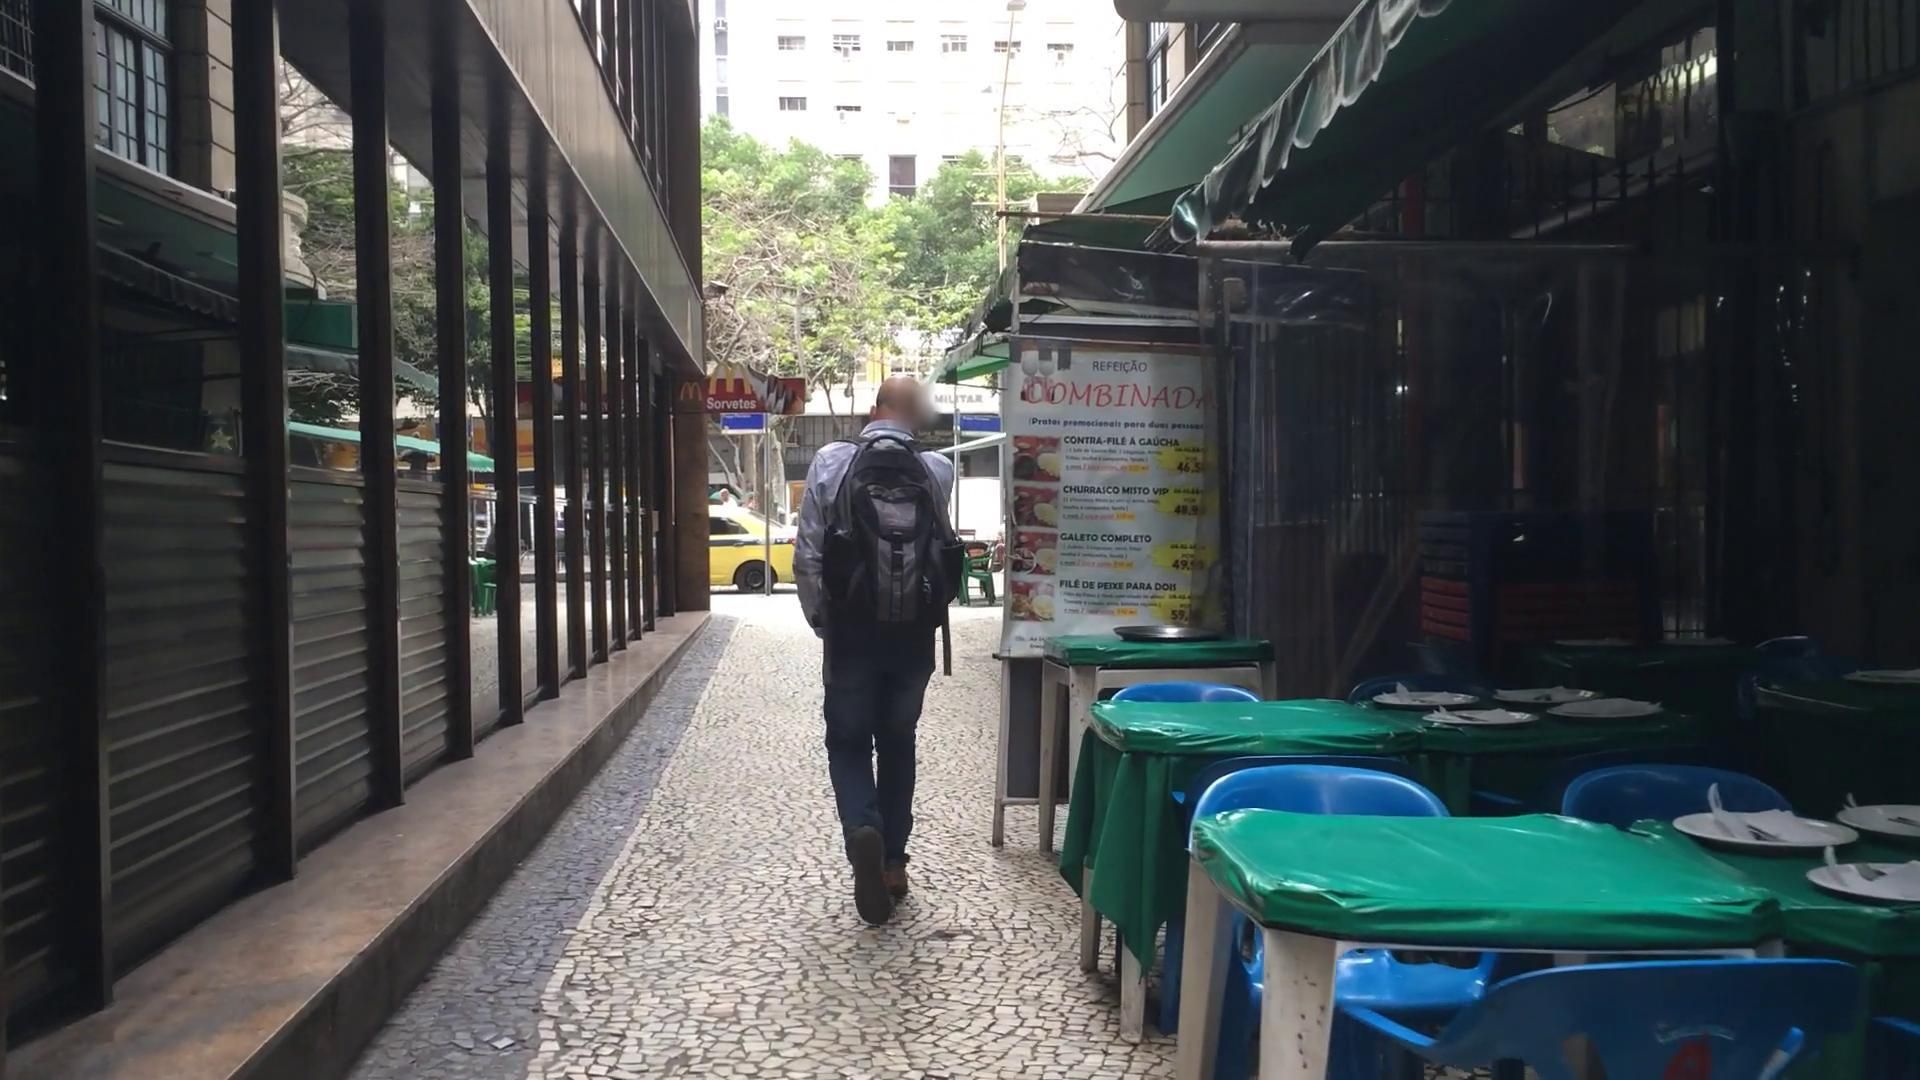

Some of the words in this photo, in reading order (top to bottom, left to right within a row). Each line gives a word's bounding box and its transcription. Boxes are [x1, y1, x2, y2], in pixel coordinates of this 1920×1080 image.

[1092, 361, 1147, 373] REFEIÇÃO
[706, 397, 757, 410] Sorvetes
[935, 394, 983, 403] MILITAR
[1063, 420, 1122, 428] promocionais
[1124, 422, 1146, 430] para
[1148, 422, 1169, 430] duas
[1063, 435, 1127, 446] CONTRA-FILÉ
[1139, 437, 1180, 447] GAÚCHA
[1063, 485, 1119, 495] CHURRASCO
[1122, 486, 1150, 495] MISTO
[1060, 532, 1098, 542] GALETO
[1100, 532, 1152, 543] COMPLETO
[1059, 579, 1081, 589] FILÉ
[1082, 581, 1095, 590] DE
[1097, 581, 1124, 590] PEIXE
[1126, 581, 1152, 591] PARA
[1155, 582, 1176, 591] DOIS
